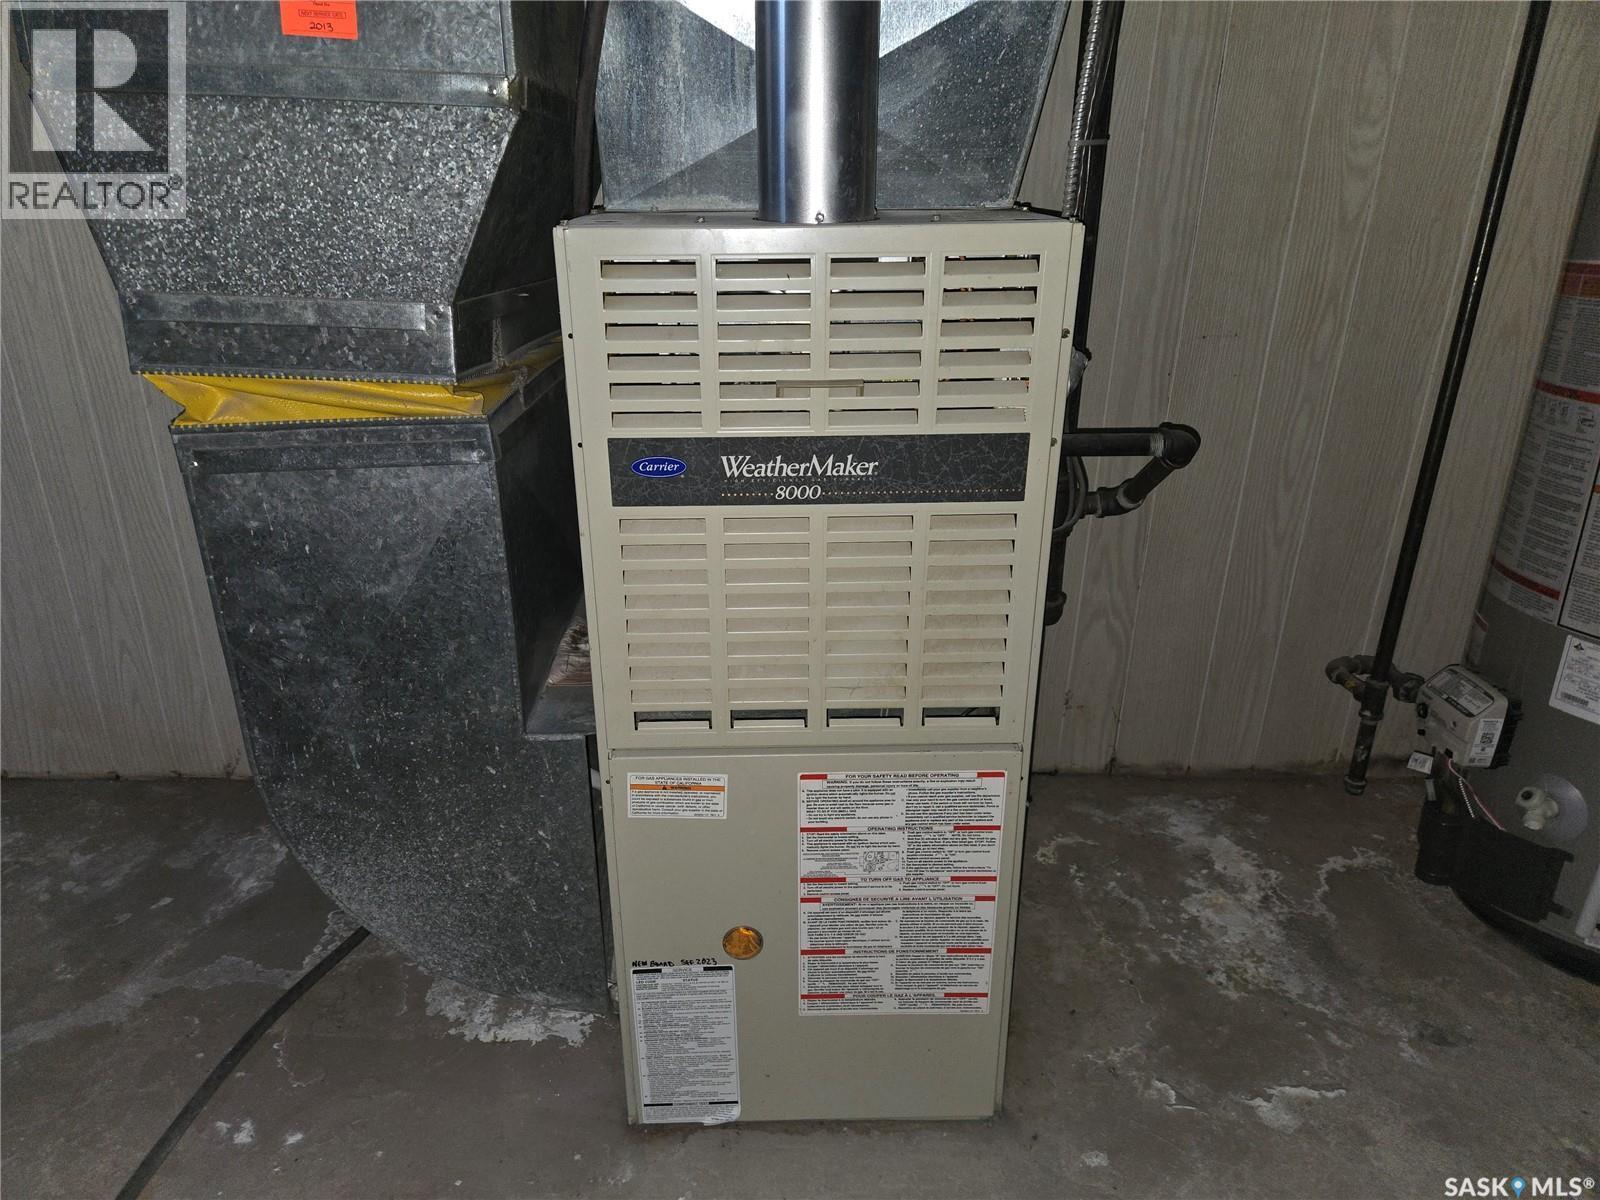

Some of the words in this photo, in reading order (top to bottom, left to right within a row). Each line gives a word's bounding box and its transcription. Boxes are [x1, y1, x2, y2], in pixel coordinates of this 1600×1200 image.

[309, 21, 334, 33] 2013
[639, 461, 680, 472] Carrier
[720, 453, 879, 478] WeatherMaker
[775, 484, 822, 500] 8000
[695, 957, 717, 965] 2023
